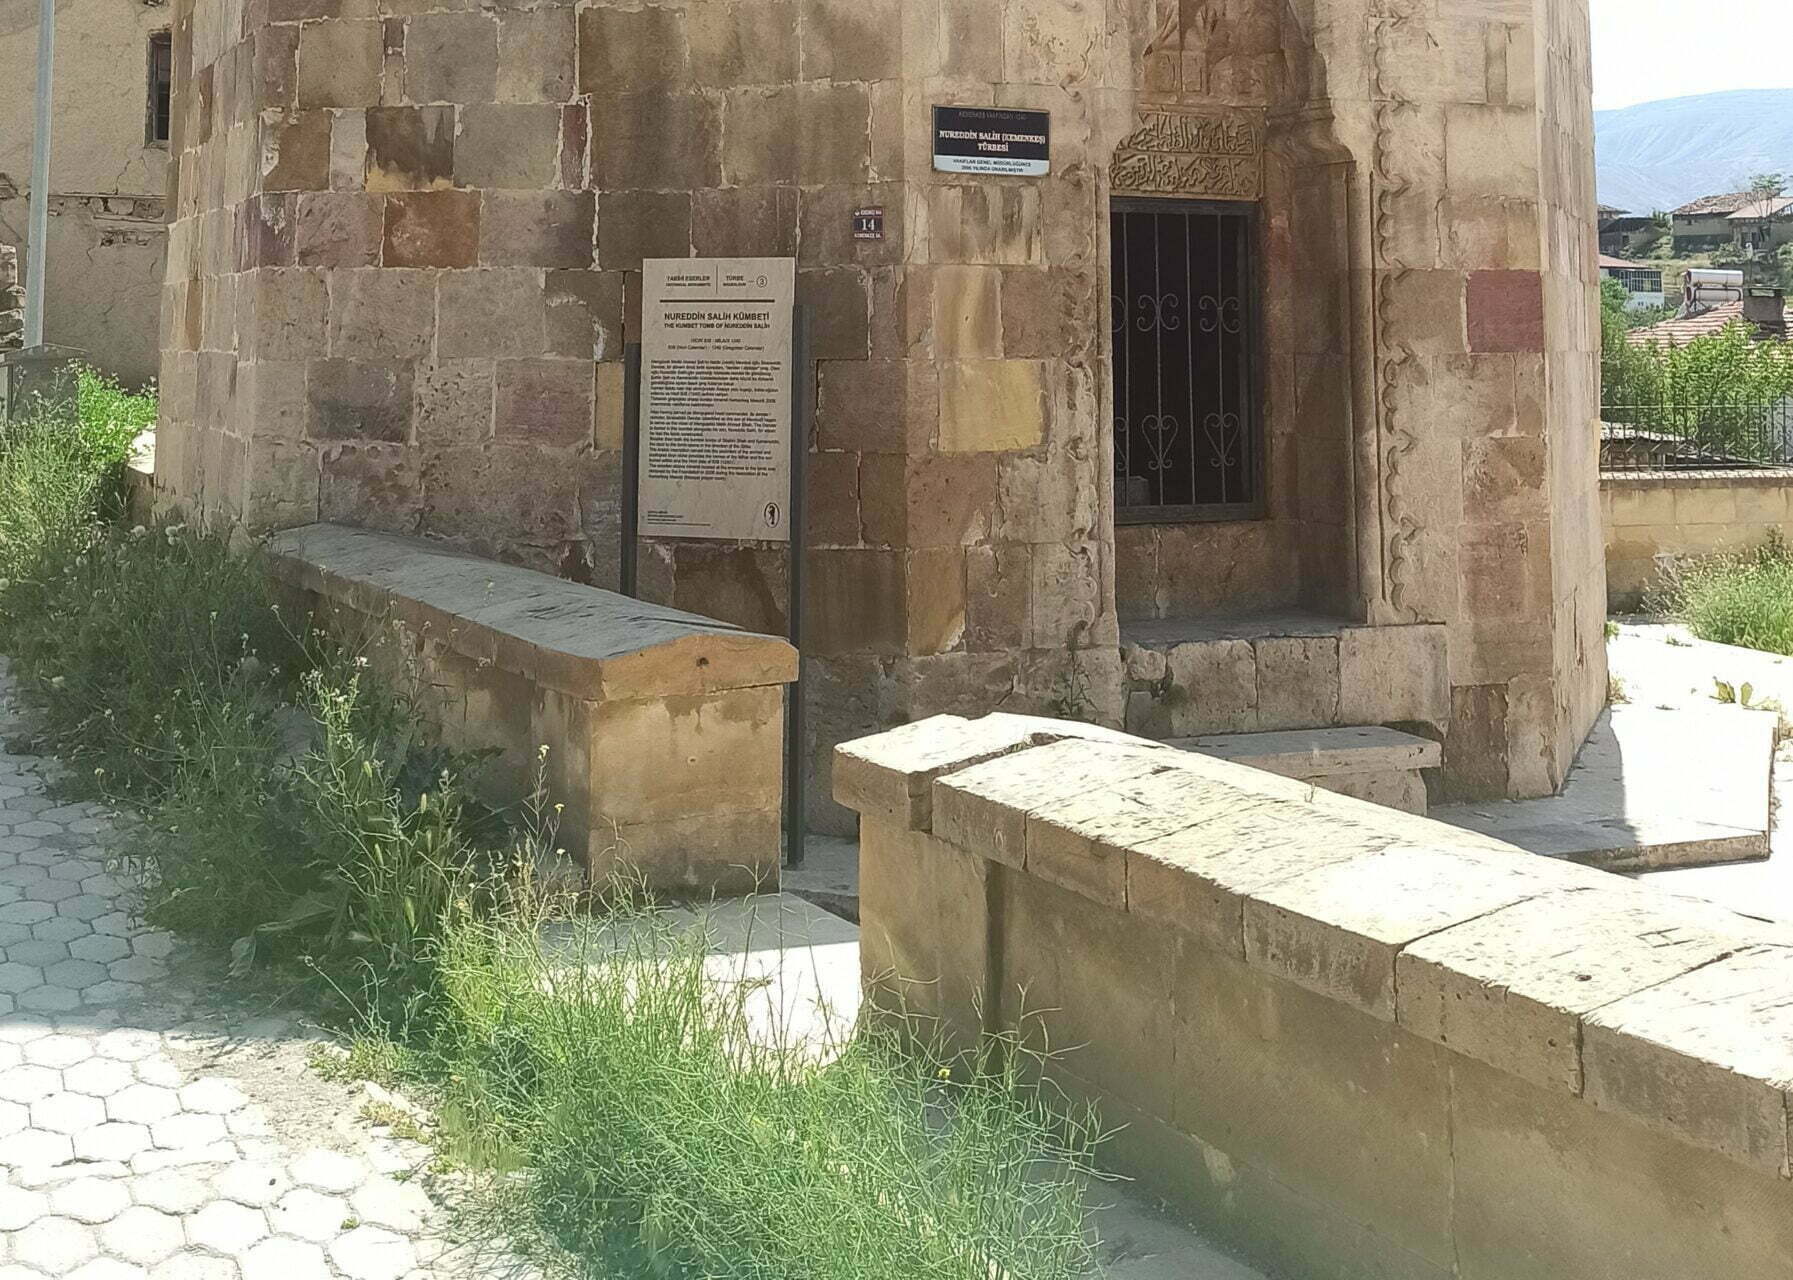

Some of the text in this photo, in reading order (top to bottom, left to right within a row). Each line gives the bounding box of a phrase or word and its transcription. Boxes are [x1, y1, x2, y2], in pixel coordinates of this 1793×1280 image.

[939, 130, 1045, 144] NUREDDİN SALİH (KEMENKEŞ)
[978, 142, 1008, 152] TÜRBESİ
[862, 219, 875, 230] 14
[664, 311, 769, 321] NUREDDİN SALİH KÜMBETİ
